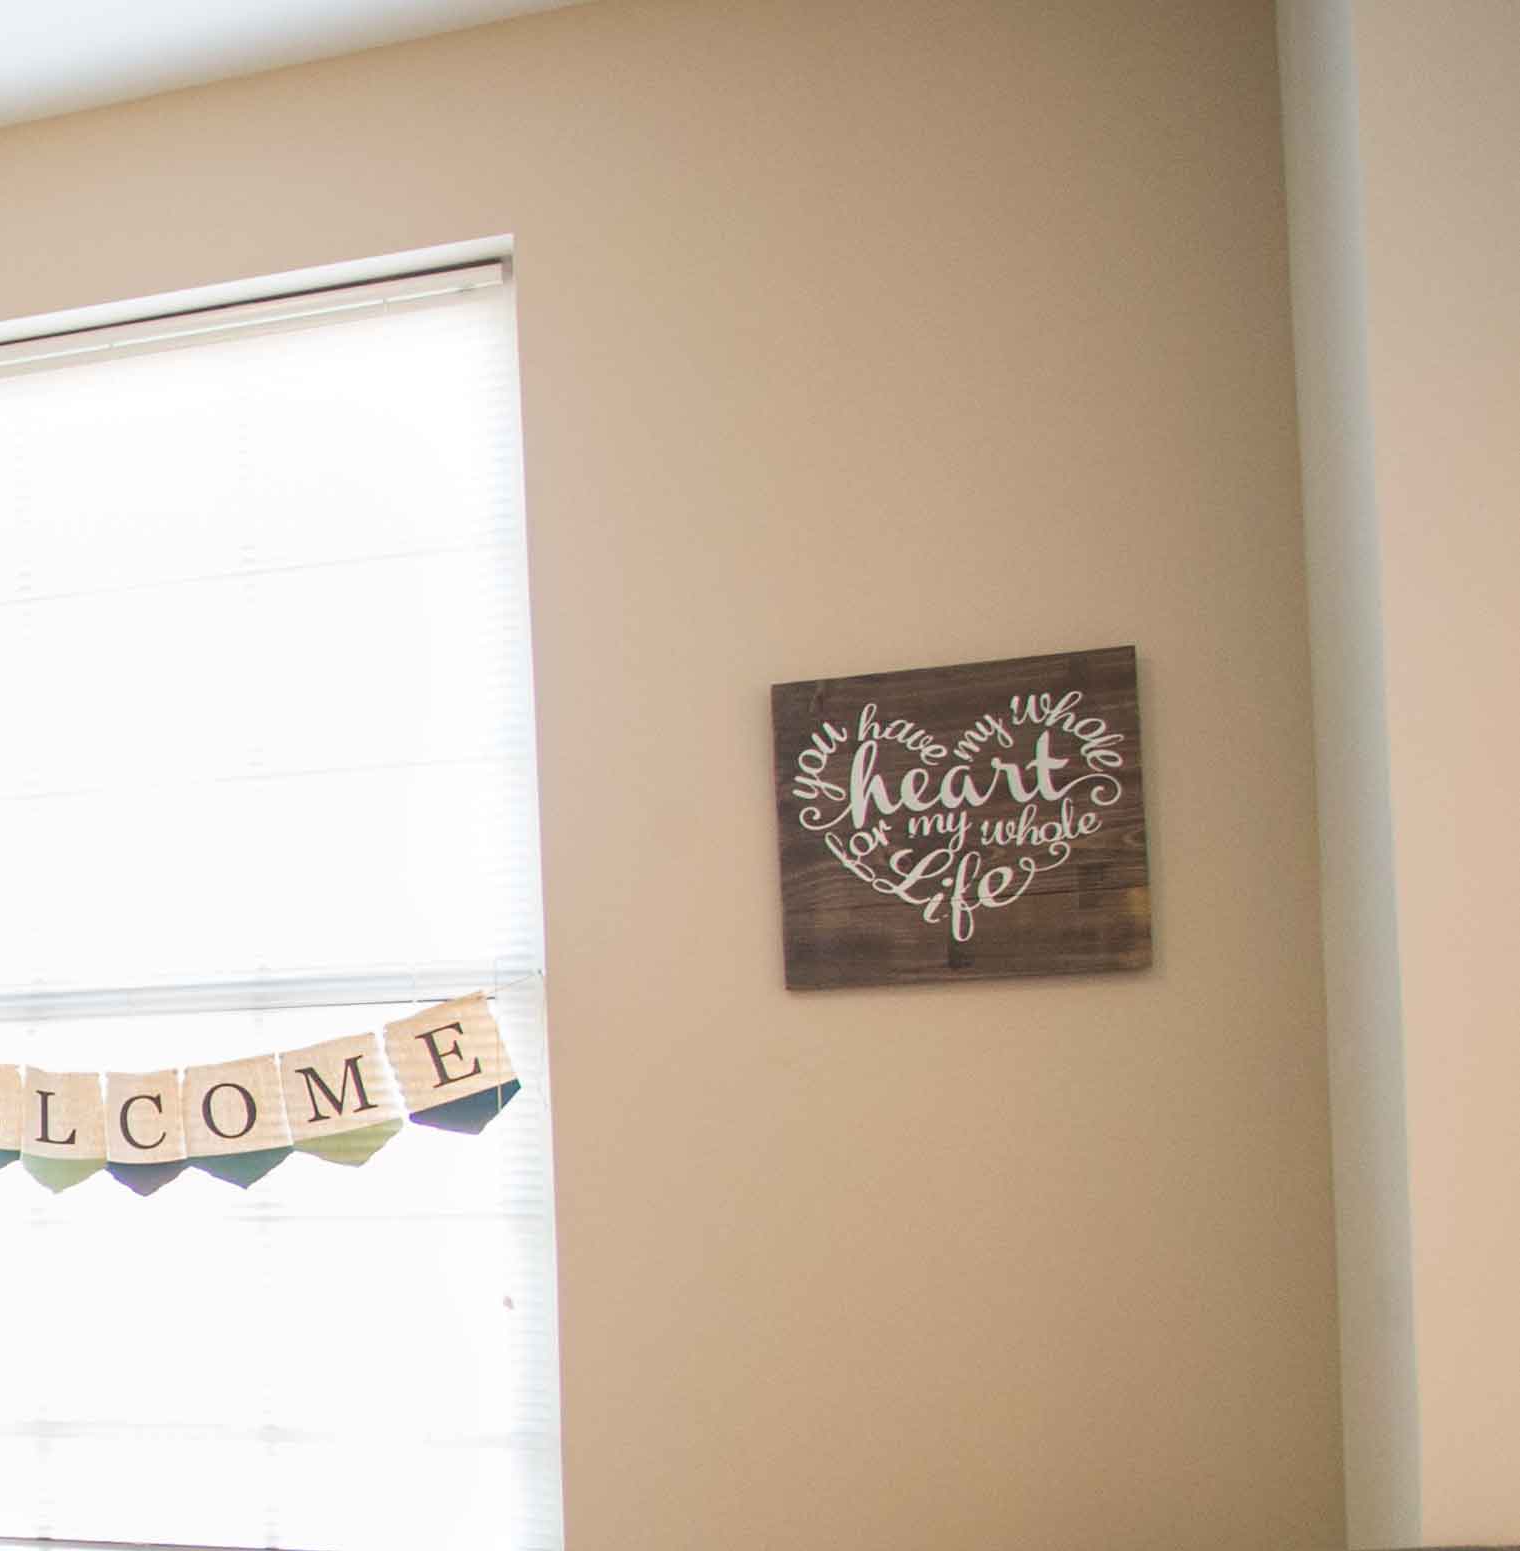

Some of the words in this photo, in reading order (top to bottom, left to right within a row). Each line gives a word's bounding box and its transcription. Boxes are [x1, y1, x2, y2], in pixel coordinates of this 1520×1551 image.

[792, 722, 847, 800] you
[859, 704, 948, 766] have
[954, 715, 1014, 762] my
[1011, 690, 1124, 771] whole
[799, 730, 1121, 830] heart
[825, 820, 892, 882] for
[908, 811, 972, 854] my
[981, 797, 1102, 846] whole
[872, 840, 1071, 941] Life
